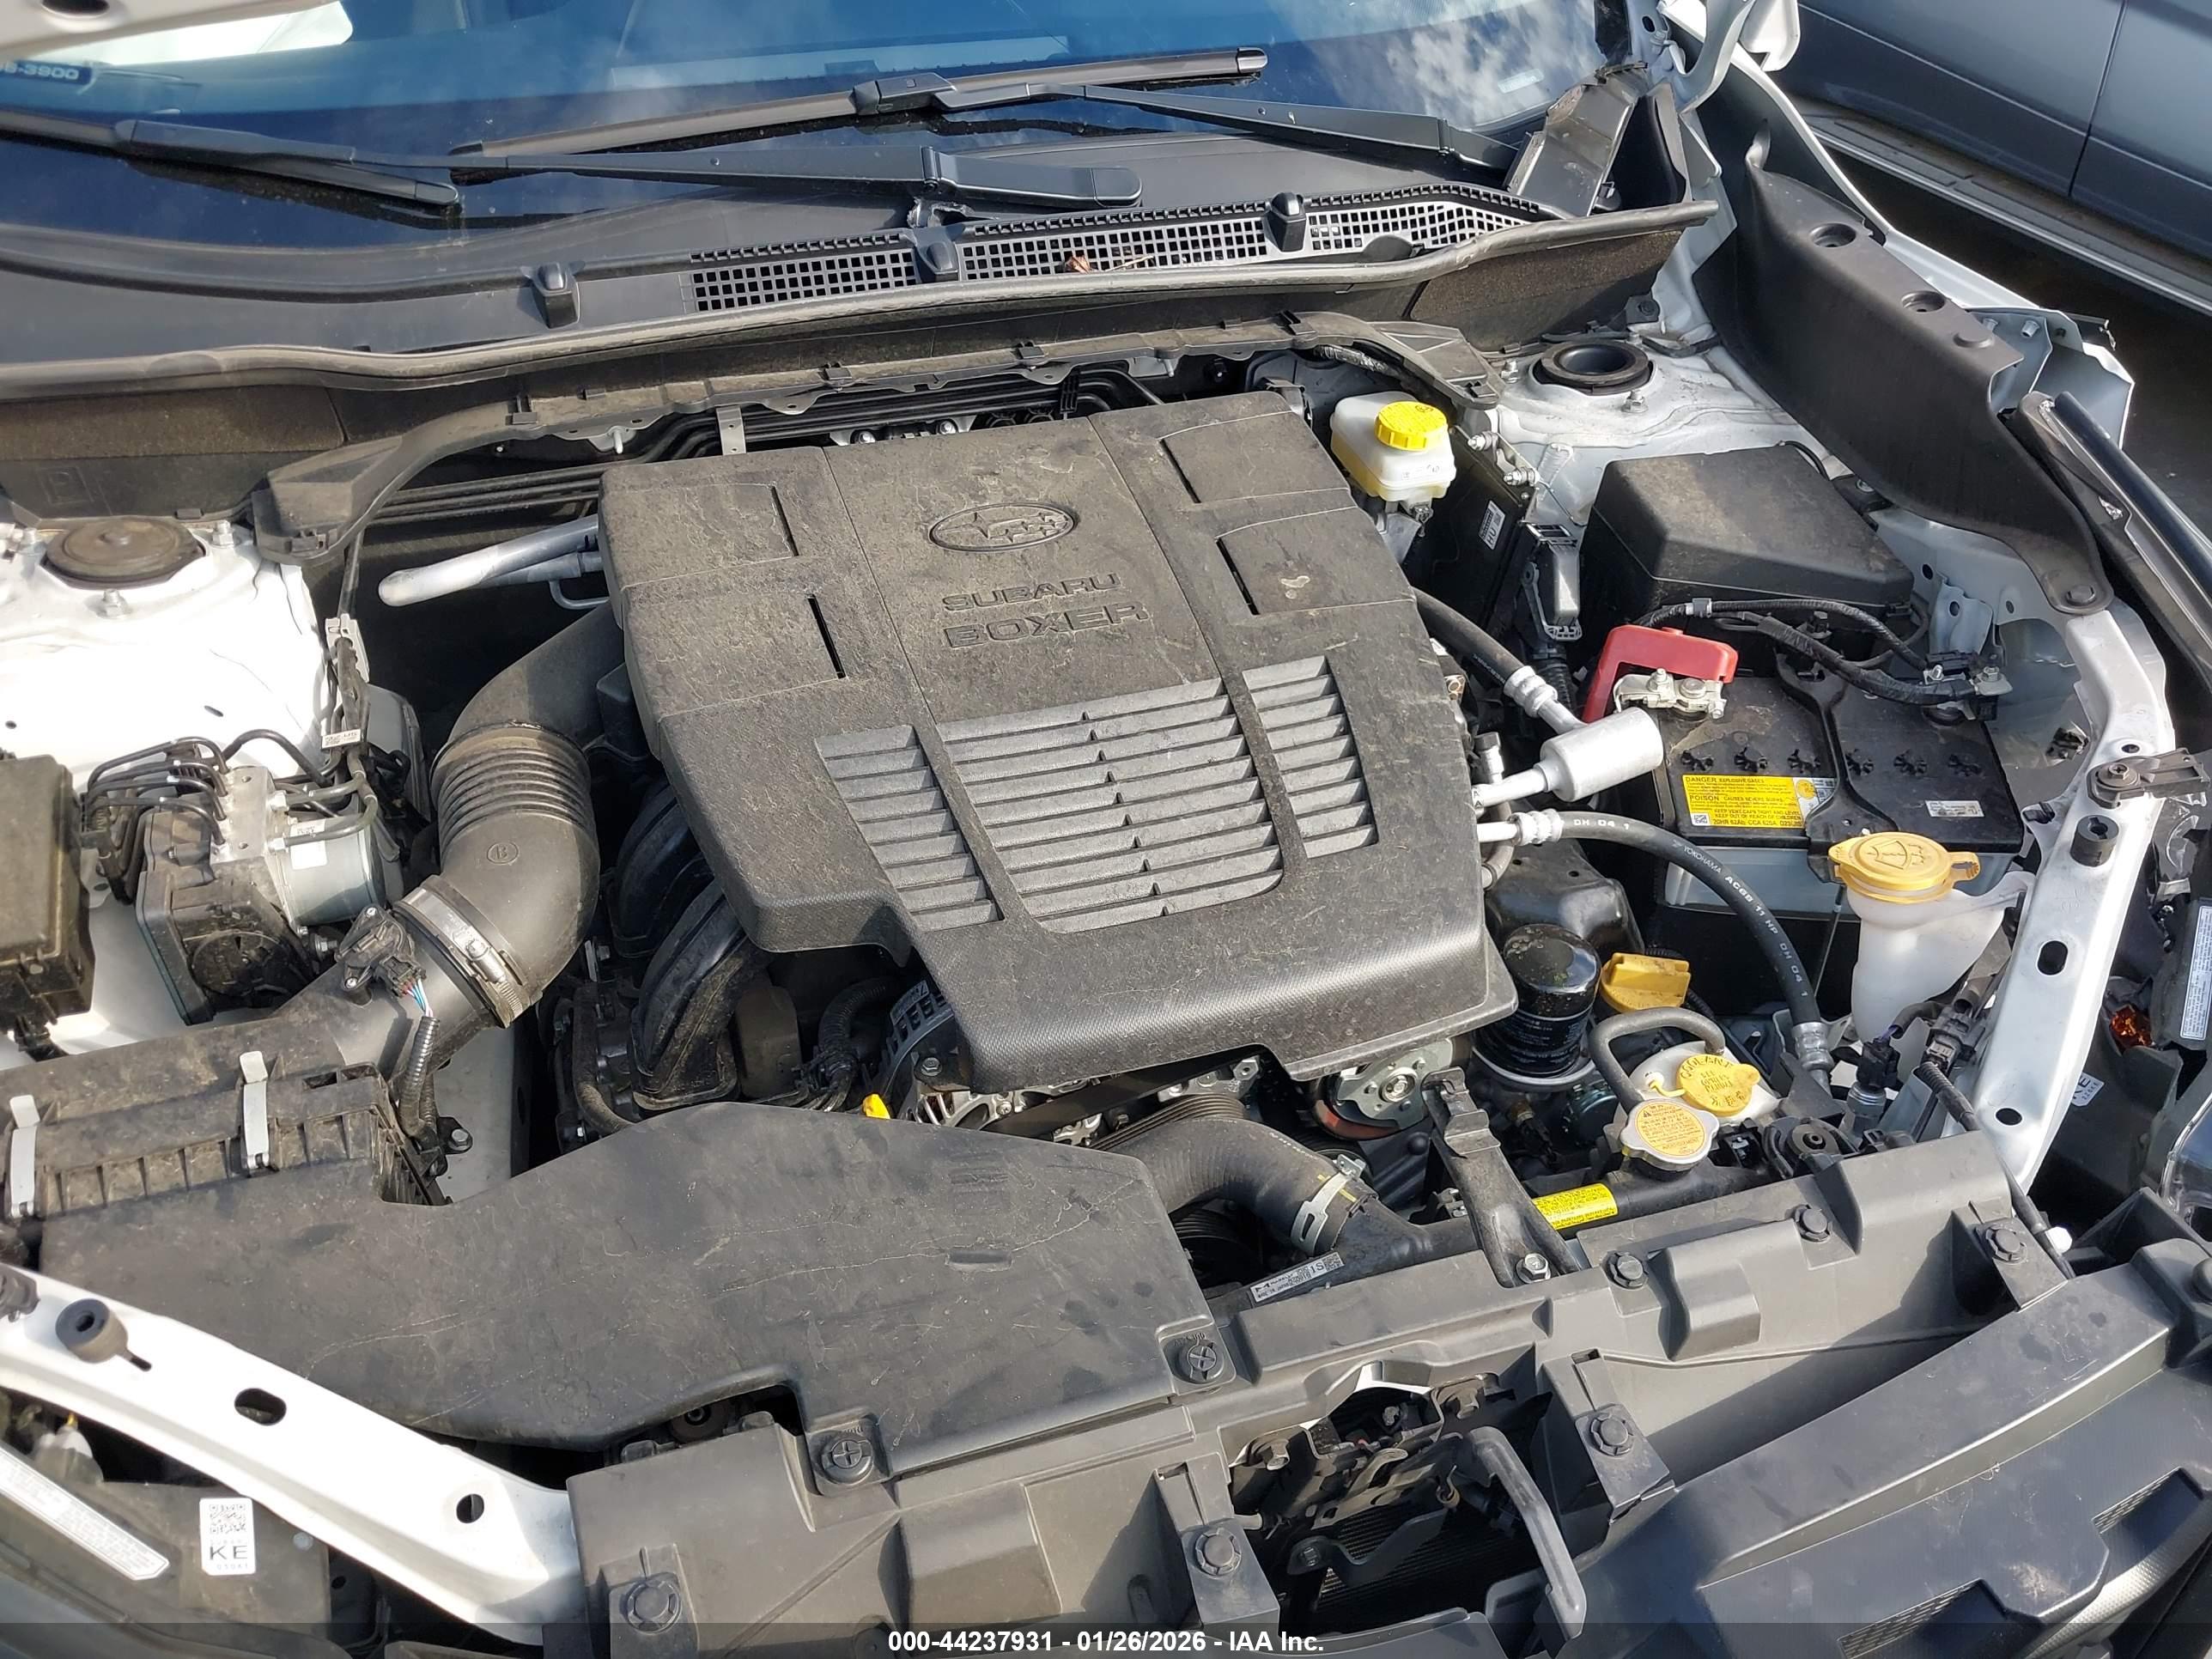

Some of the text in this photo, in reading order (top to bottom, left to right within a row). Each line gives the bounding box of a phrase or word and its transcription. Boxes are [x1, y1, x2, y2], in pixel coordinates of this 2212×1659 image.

[1486, 526, 1498, 546] HU
[943, 573, 1121, 611] SUBARU
[945, 602, 1150, 648] BOXER
[1683, 845, 1722, 874] YOKOHAMA
[1680, 1055, 1734, 1079] COOLANT
[210, 1546, 248, 1559] KE
